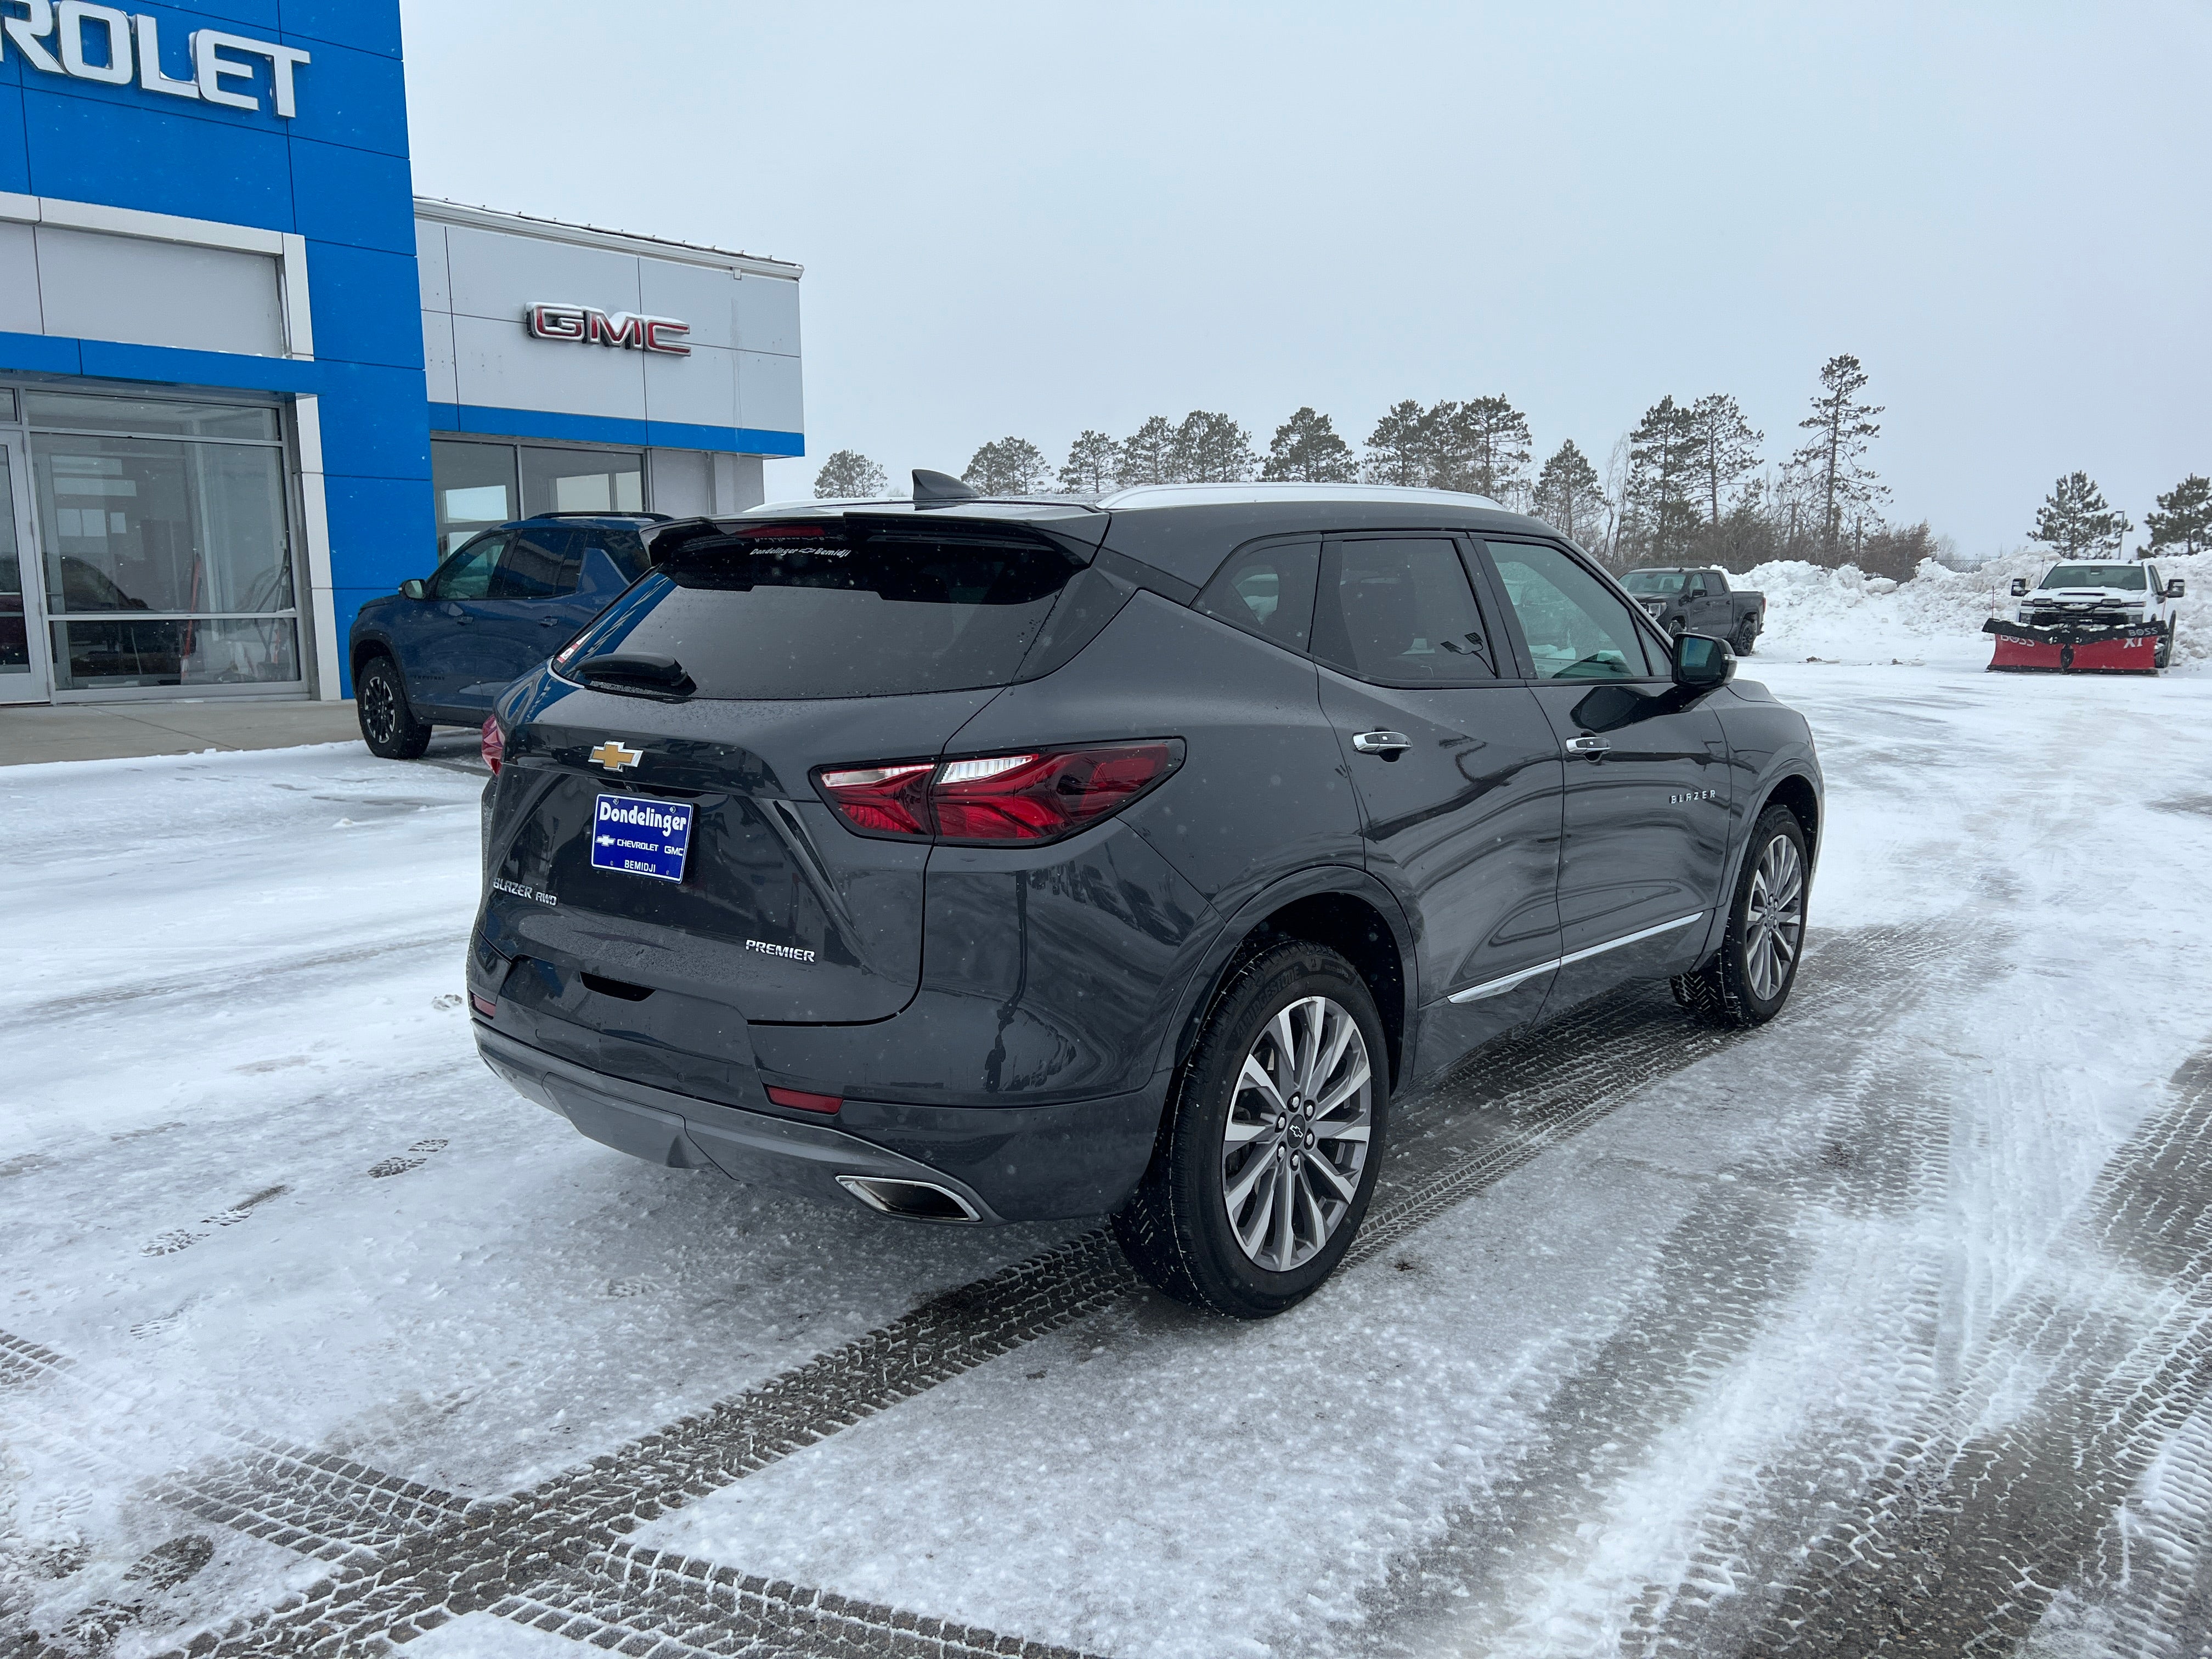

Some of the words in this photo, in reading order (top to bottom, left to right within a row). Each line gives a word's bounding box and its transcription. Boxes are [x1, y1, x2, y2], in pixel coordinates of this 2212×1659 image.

[527, 303, 691, 357] GMC
[749, 548, 799, 556] Dondelinger
[814, 548, 851, 558] Bemidji
[2129, 627, 2158, 636] BOSS
[1670, 789, 1716, 804] BLAZER
[599, 801, 687, 837] Dondelinger
[616, 838, 659, 852] CHEVROLET
[664, 845, 685, 856] GMC
[624, 859, 656, 873] BEMIDJI
[493, 877, 534, 899] BLAZER
[535, 891, 557, 906] AWD
[745, 939, 815, 963] PREMIER
